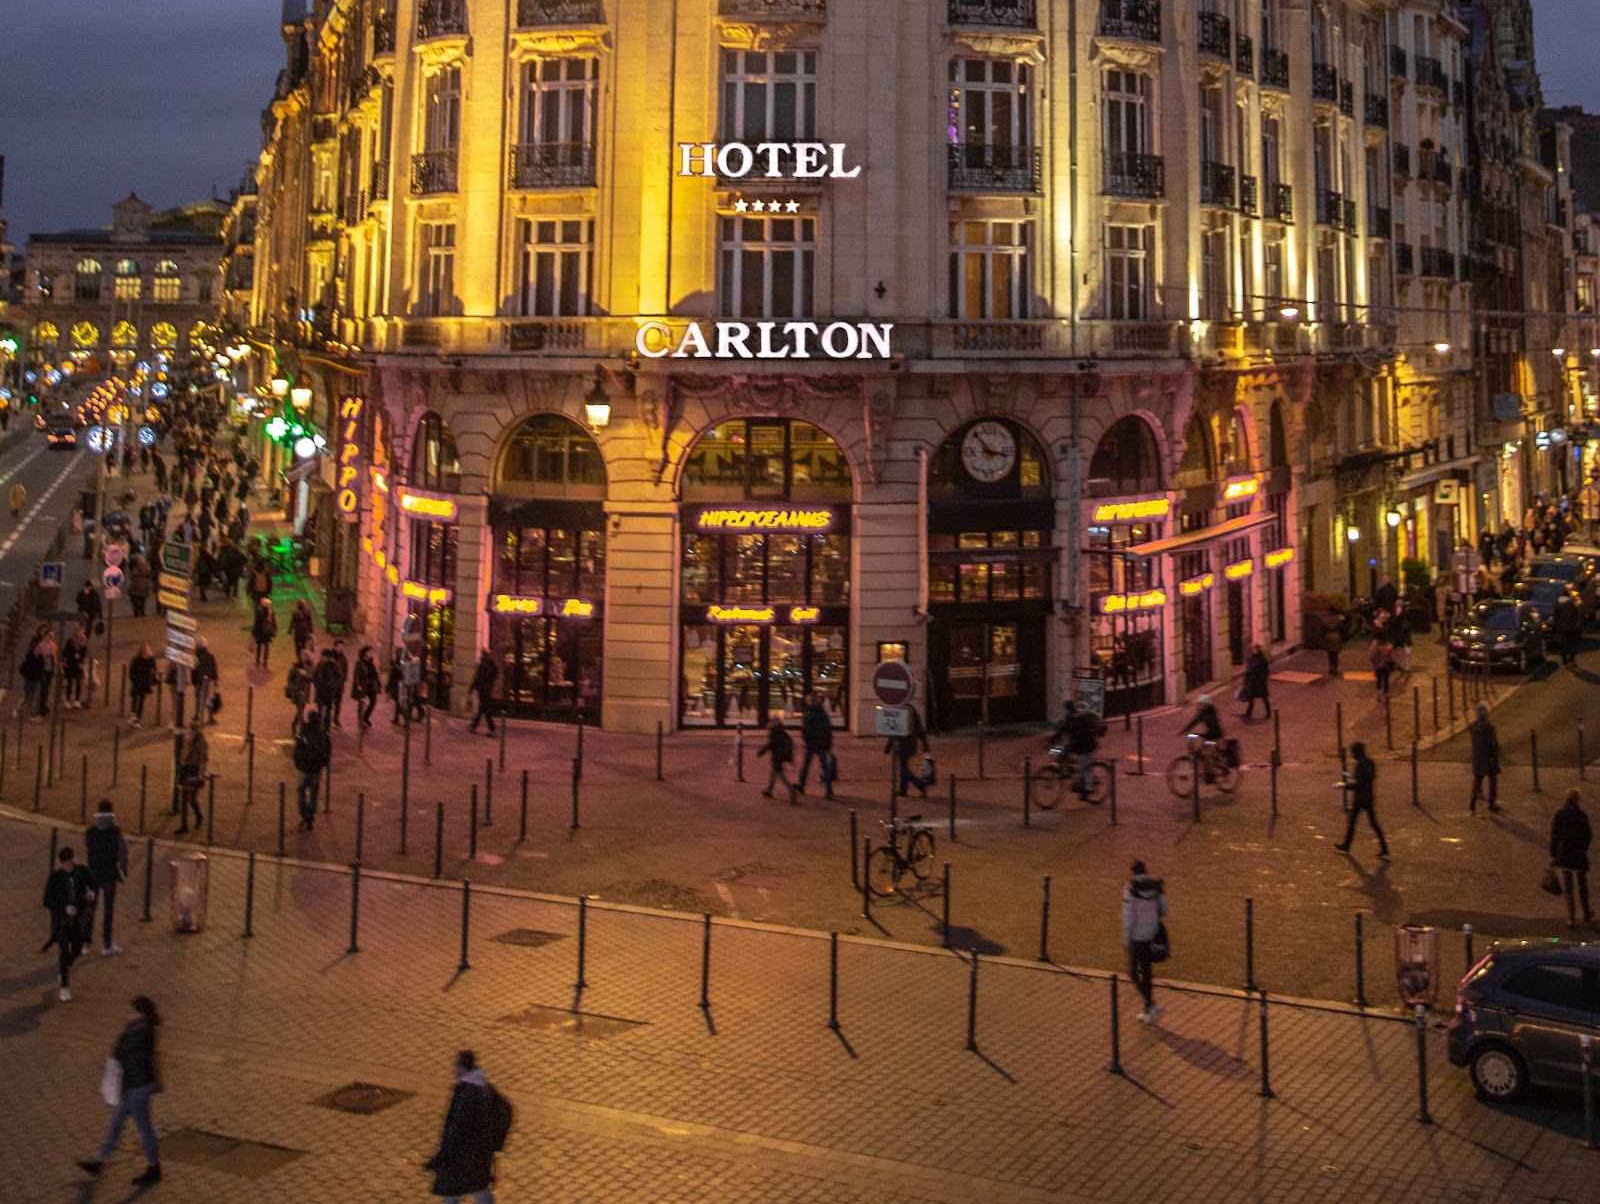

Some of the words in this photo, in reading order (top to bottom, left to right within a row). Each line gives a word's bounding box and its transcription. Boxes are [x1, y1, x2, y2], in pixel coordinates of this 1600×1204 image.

[677, 142, 861, 178] HOTEL
[635, 321, 894, 359] CARLTON
[340, 397, 363, 512] HIPPO
